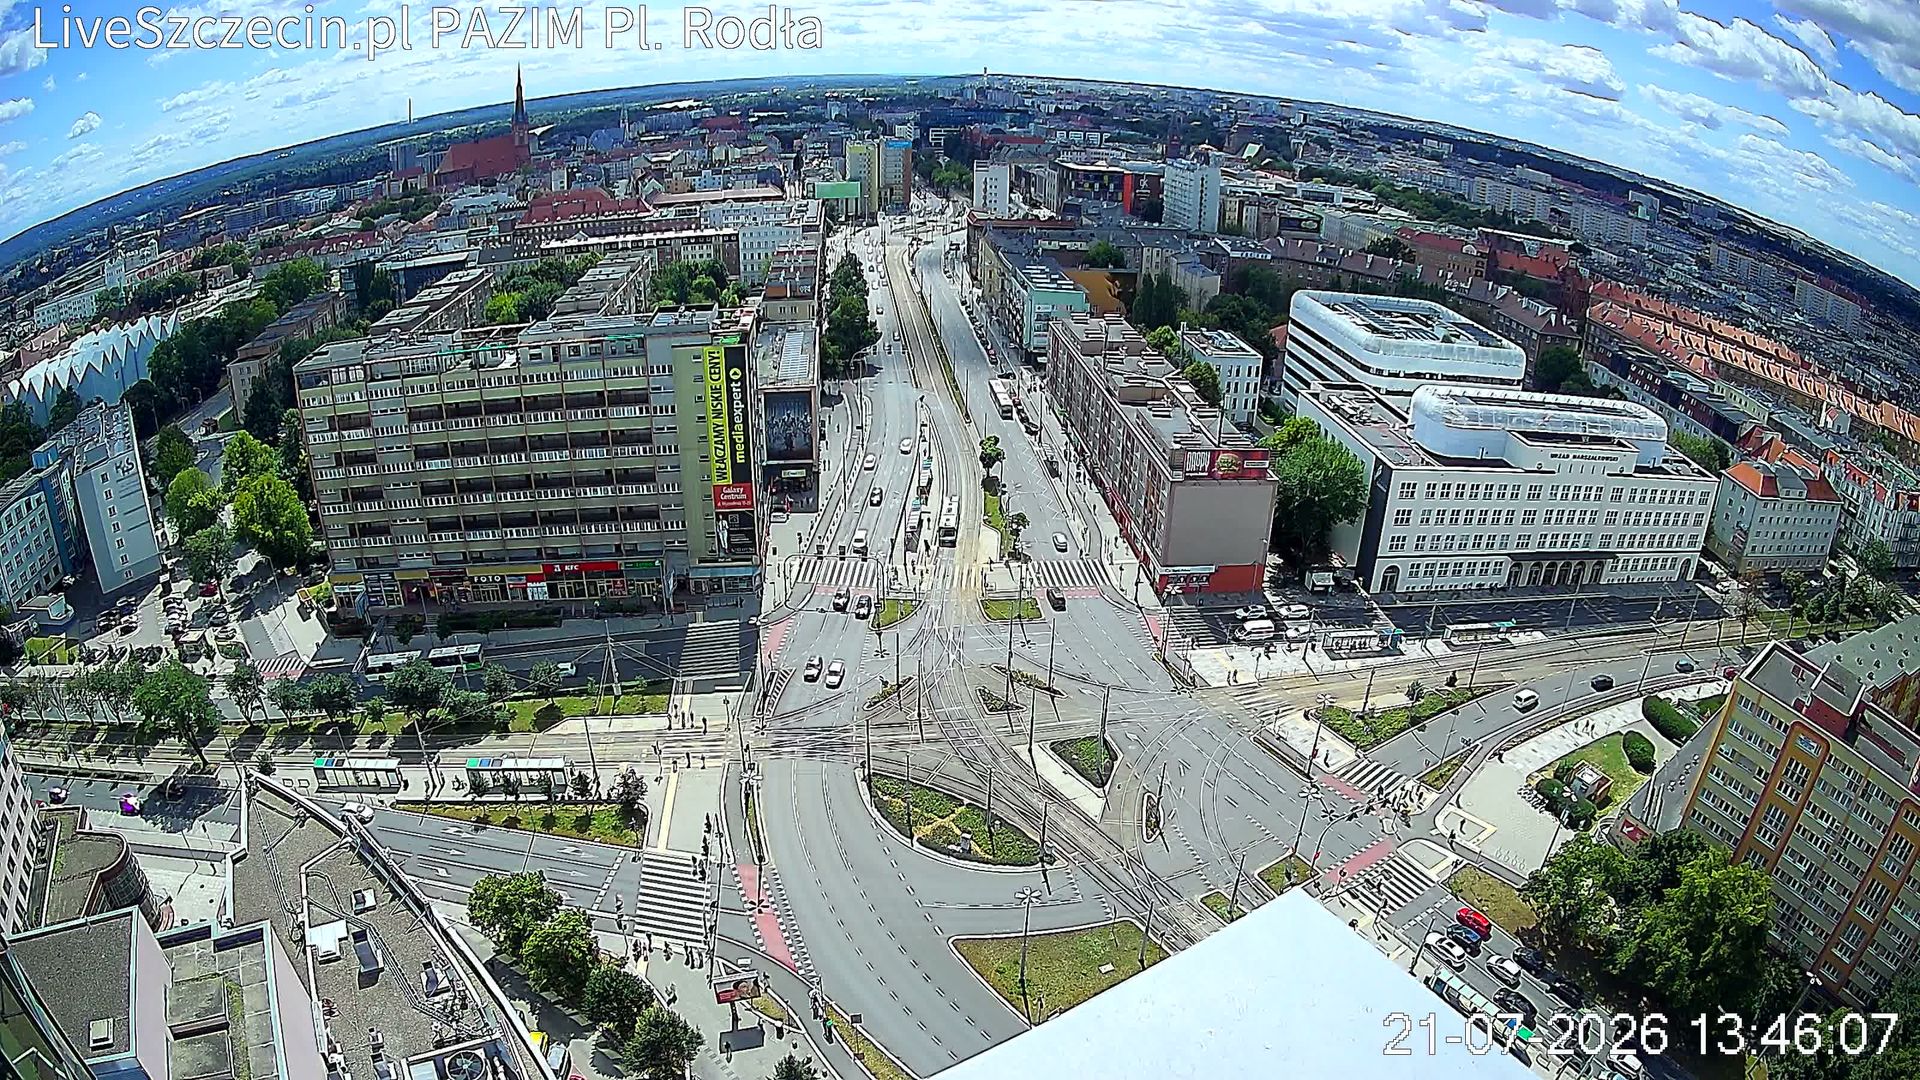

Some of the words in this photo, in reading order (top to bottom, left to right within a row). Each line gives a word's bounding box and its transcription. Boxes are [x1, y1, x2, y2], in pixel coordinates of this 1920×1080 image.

[708, 350, 722, 383] CENY!
[710, 384, 724, 420] NISKIE
[730, 381, 745, 463] mediaexpert
[722, 486, 744, 495] Galaxy
[474, 575, 501, 583] FOTO
